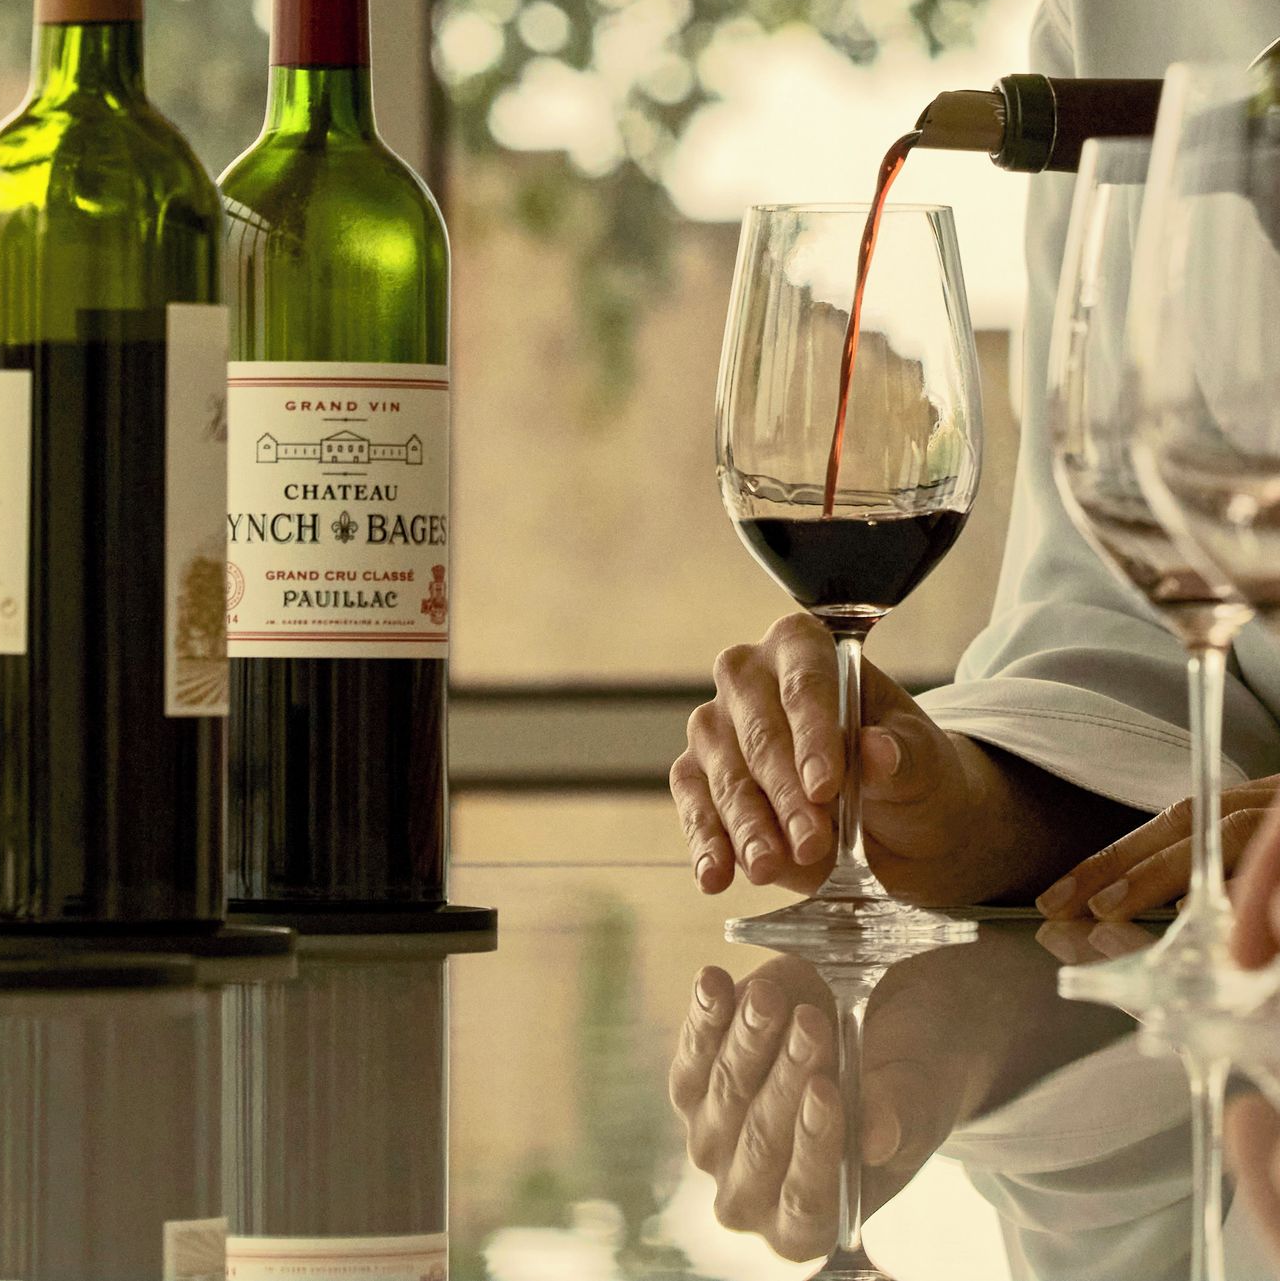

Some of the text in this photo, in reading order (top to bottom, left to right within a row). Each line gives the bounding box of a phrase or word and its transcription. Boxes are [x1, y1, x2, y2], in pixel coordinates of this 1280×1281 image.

[285, 401, 401, 412] GRAND VIN
[284, 484, 398, 501] CHATEAU
[227, 513, 447, 546] YNCH BAGES
[265, 568, 415, 582] GRAND CRU CLASSÉ
[283, 590, 398, 609] PAUILLAC
